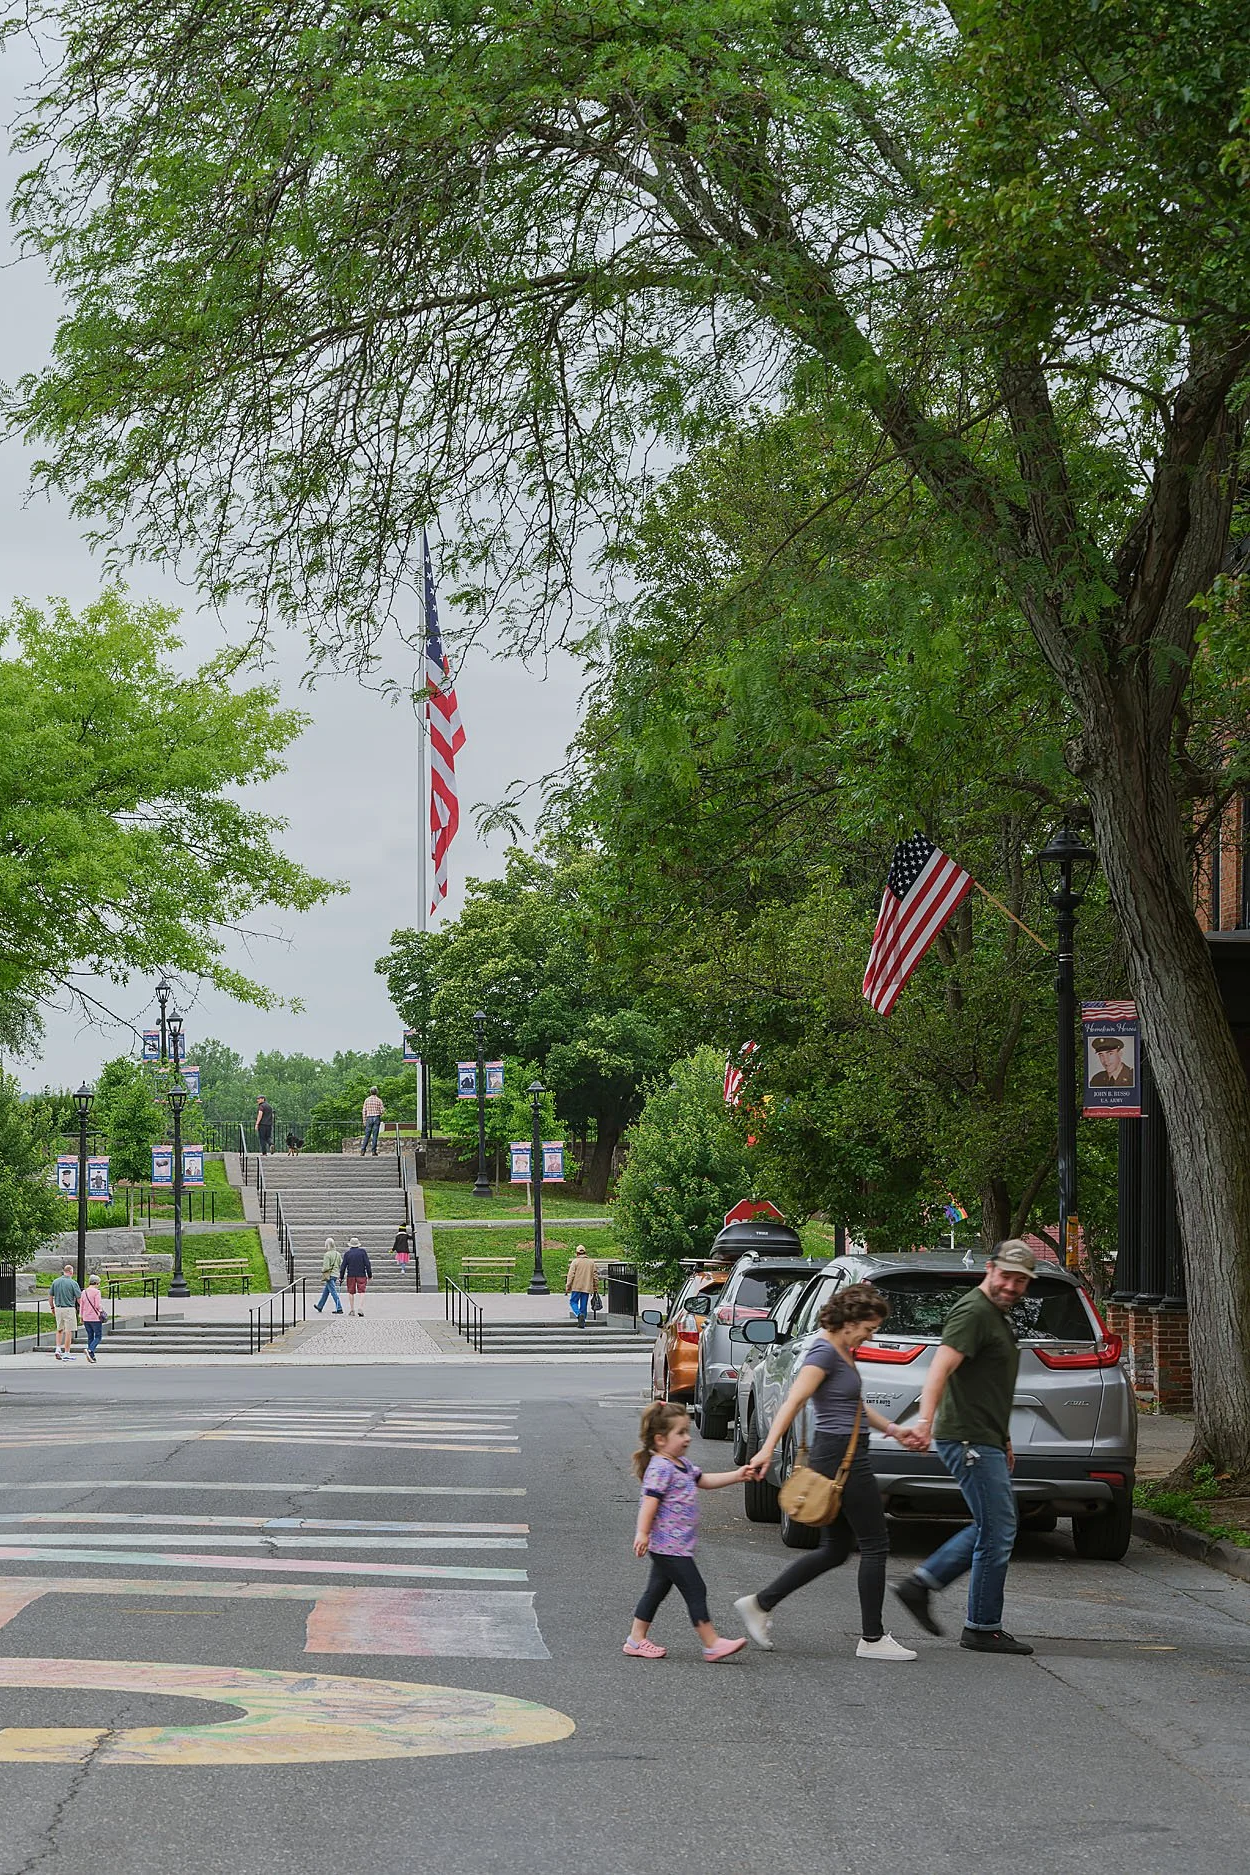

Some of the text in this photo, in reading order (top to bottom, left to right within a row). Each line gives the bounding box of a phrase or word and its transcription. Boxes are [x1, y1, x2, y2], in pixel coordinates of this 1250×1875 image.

[1084, 1022, 1137, 1033] Hometown Heroes
[866, 1391, 903, 1400] CR-V
